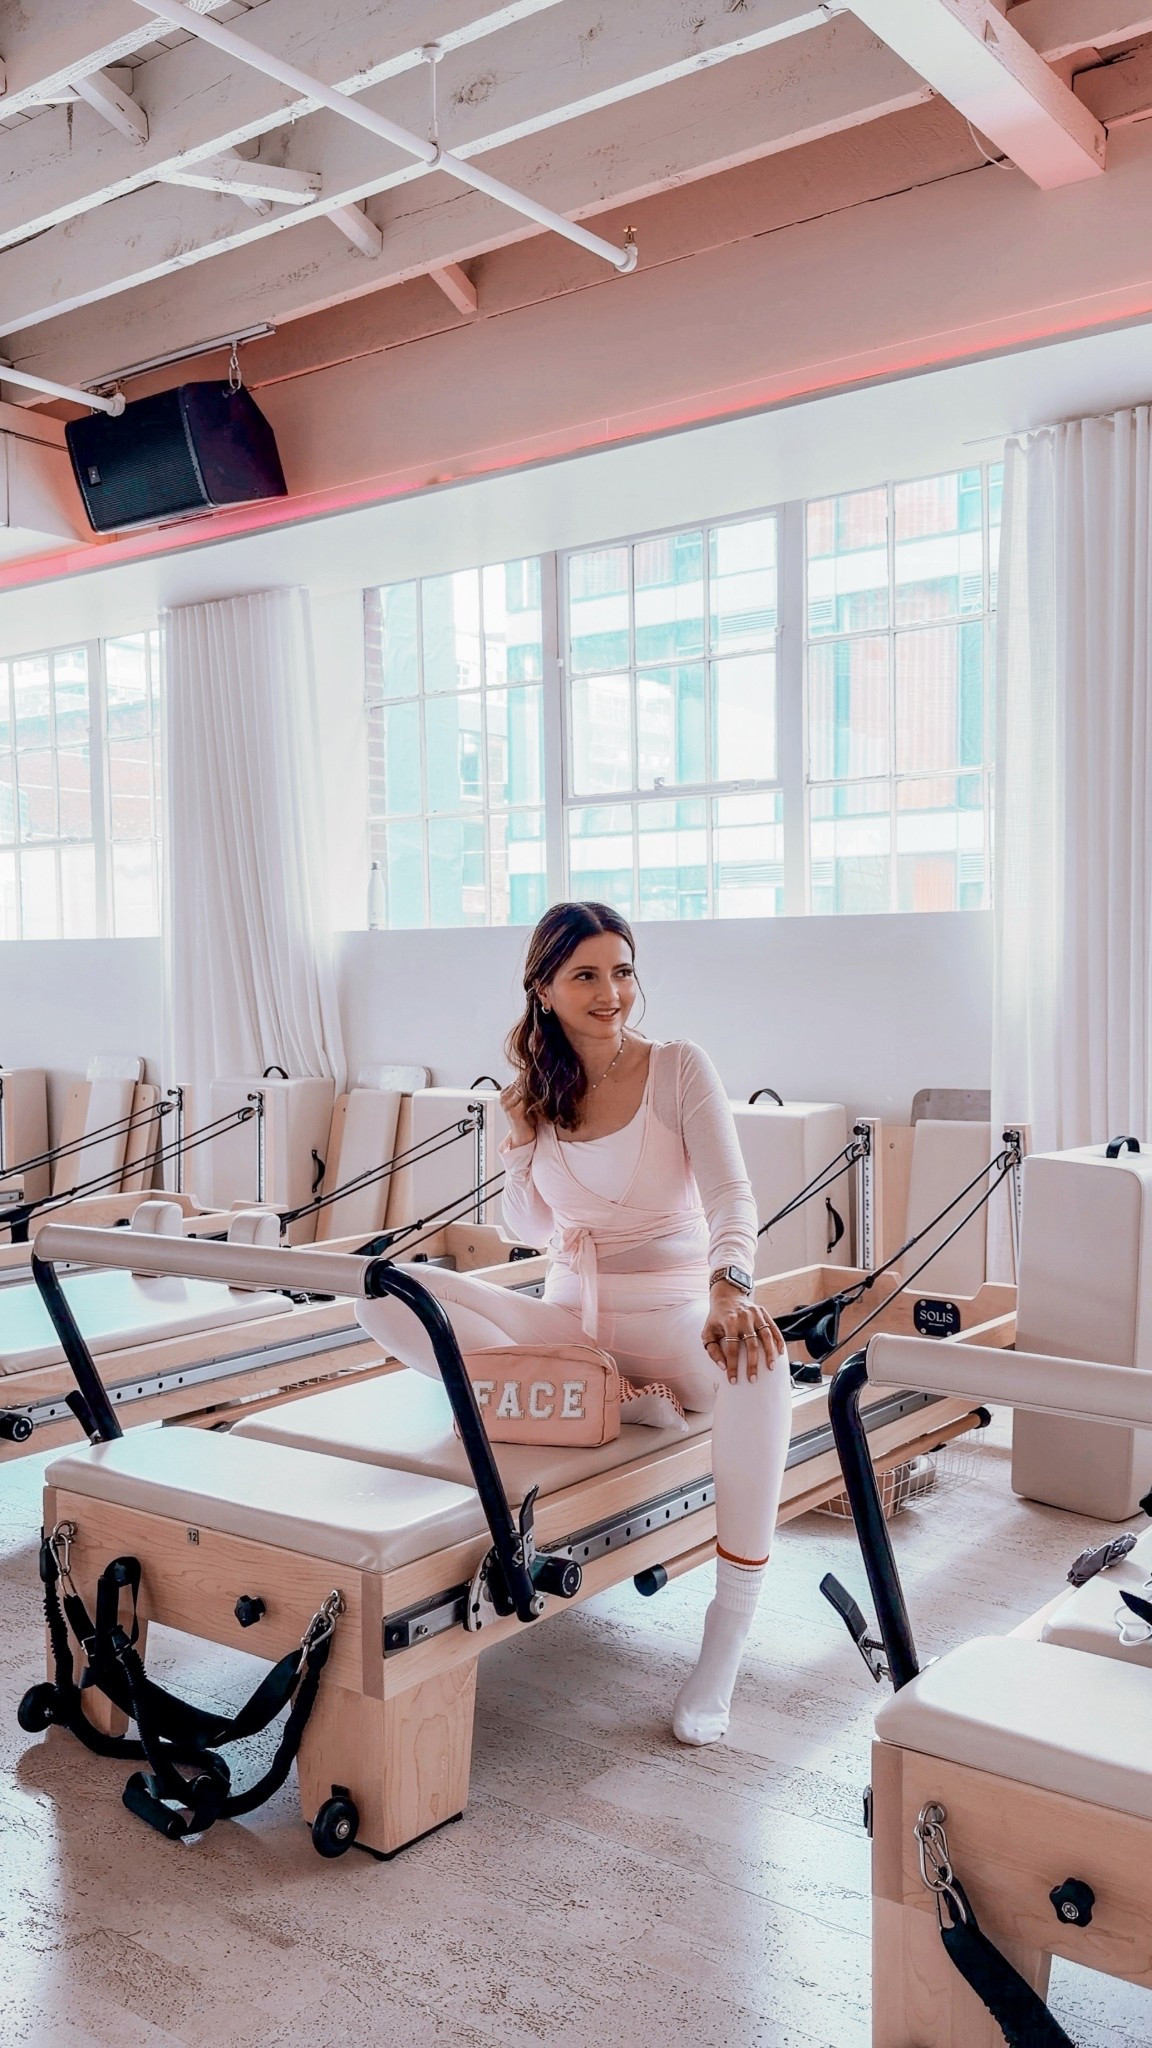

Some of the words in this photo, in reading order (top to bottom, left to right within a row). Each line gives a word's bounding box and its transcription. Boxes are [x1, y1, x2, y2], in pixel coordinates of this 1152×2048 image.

[920, 1310, 953, 1323] SOLIS
[472, 1380, 586, 1419] FACE
[188, 1531, 197, 1541] 12
